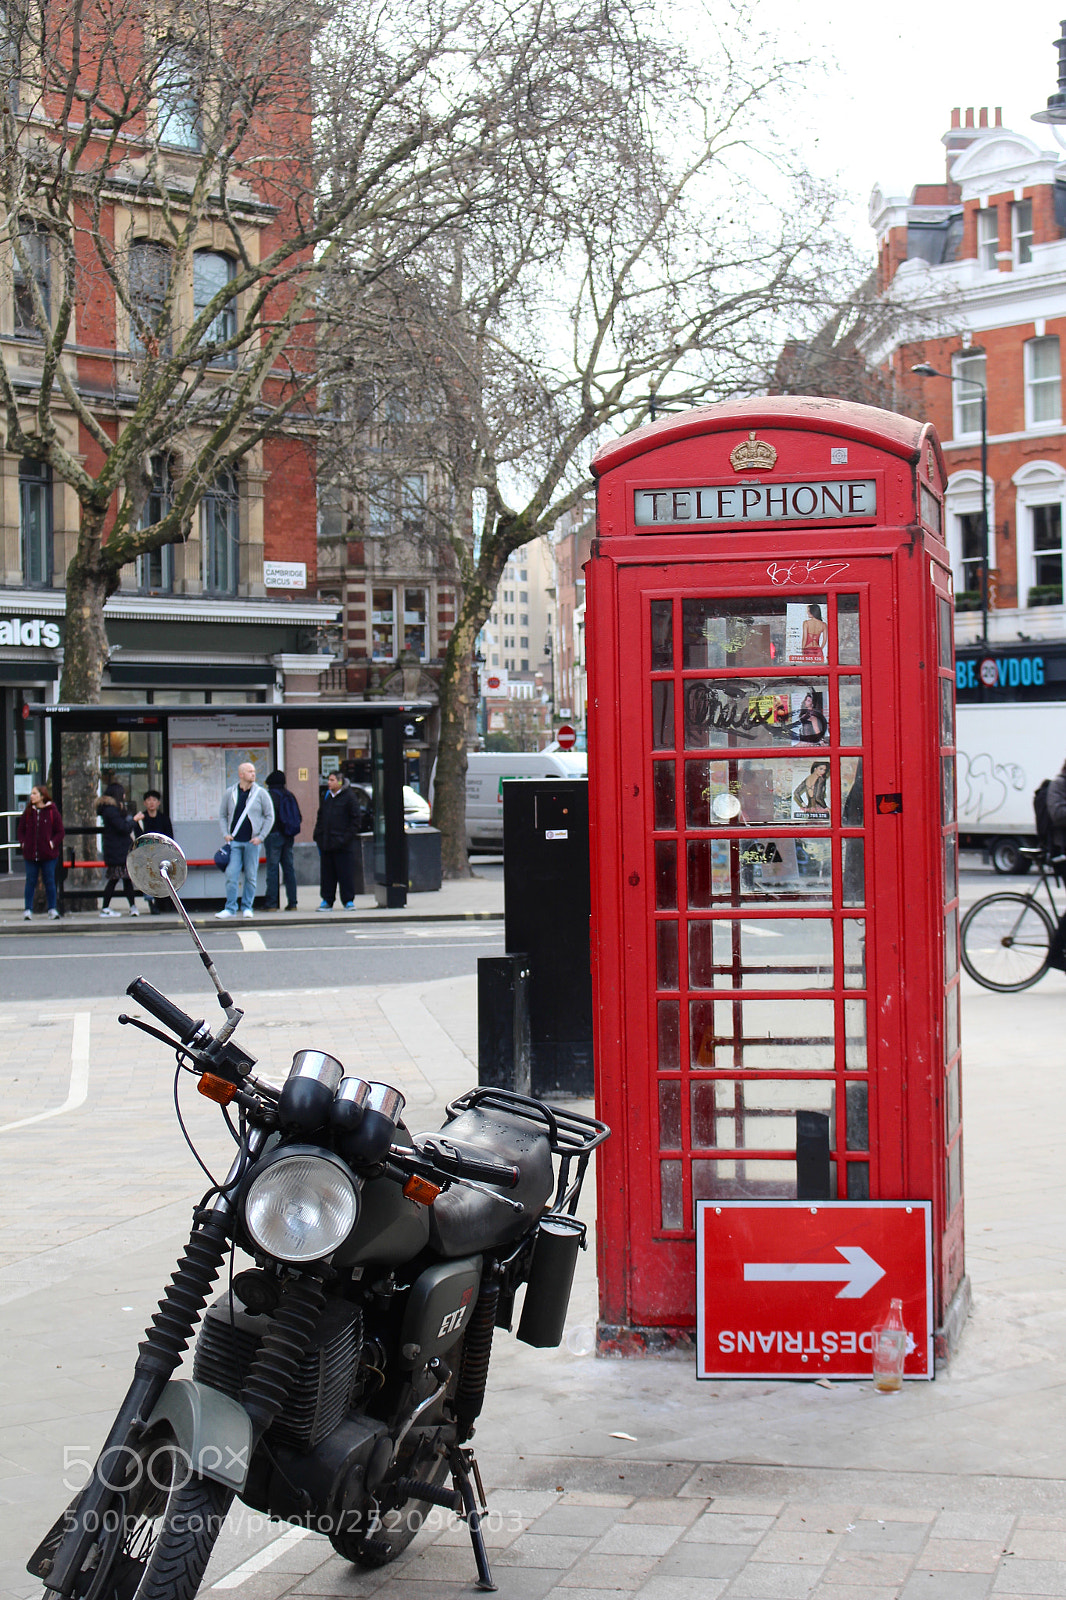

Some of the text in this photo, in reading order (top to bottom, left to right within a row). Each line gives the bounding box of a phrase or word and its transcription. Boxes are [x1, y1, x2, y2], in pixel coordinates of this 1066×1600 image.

[643, 484, 867, 521] TELEPHONE
[265, 569, 303, 577] CAMBRIDGE
[265, 577, 291, 585] CIRCUS
[718, 1331, 914, 1354] DESTRIANS
